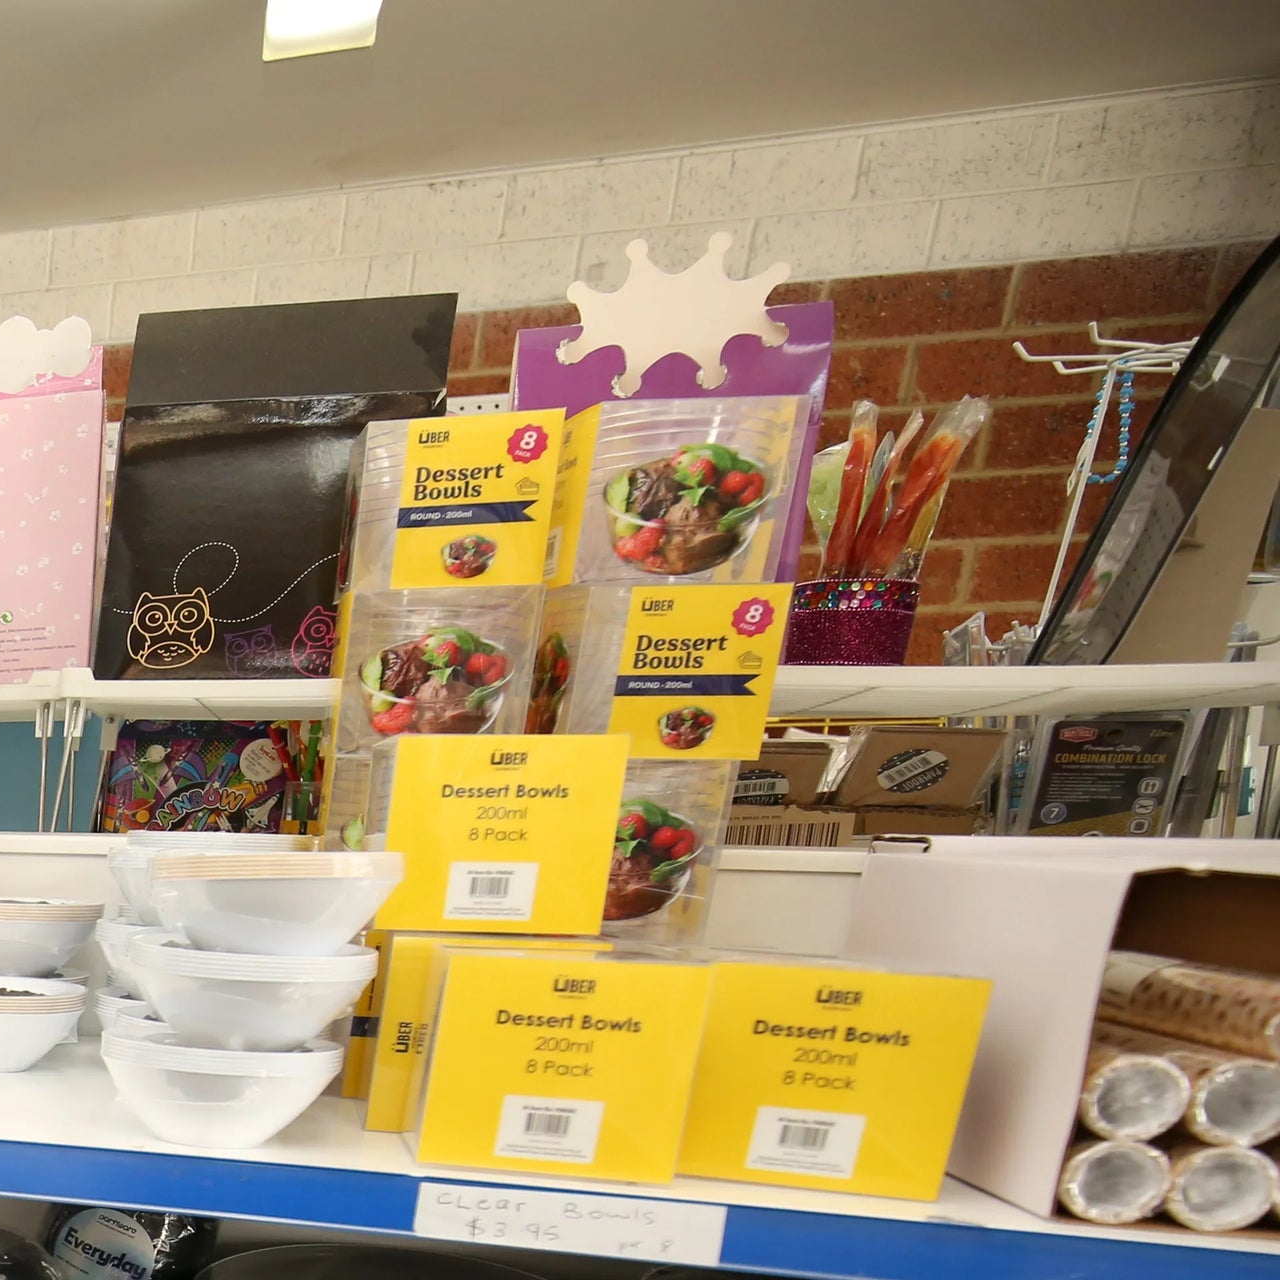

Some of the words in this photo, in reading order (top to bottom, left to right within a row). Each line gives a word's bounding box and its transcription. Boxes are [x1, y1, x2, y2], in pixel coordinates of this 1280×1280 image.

[520, 431, 538, 450] 8
[416, 463, 504, 484] Dessert
[414, 481, 482, 501] Bowls
[410, 512, 441, 521] ROUND
[445, 510, 473, 519] 200ml
[745, 604, 764, 623] 8
[636, 635, 728, 652] Dessert
[633, 652, 704, 670] Bowls
[628, 681, 660, 689] ROUND
[664, 680, 692, 689] 200ml
[1054, 753, 1134, 763] COMBINATION
[1136, 753, 1167, 763] LOCK
[442, 784, 510, 798] Dessert
[516, 784, 569, 798] Bowls
[476, 806, 528, 820] 200ml
[1049, 807, 1059, 819] 7
[469, 827, 479, 841] 8
[485, 827, 528, 842] Pack
[496, 1009, 575, 1029] Dessert
[582, 1015, 642, 1033] Bowls
[753, 1019, 837, 1040] Dessert
[844, 1026, 911, 1047] Bowls
[535, 1036, 594, 1054] 200ml
[793, 1047, 858, 1066] 200ml
[525, 1059, 537, 1074] 8
[544, 1060, 594, 1077] Pack
[782, 1070, 796, 1085] 8
[802, 1072, 856, 1090] Pack
[562, 1202, 656, 1226] Bowls
[64, 1227, 147, 1280] Everyday
